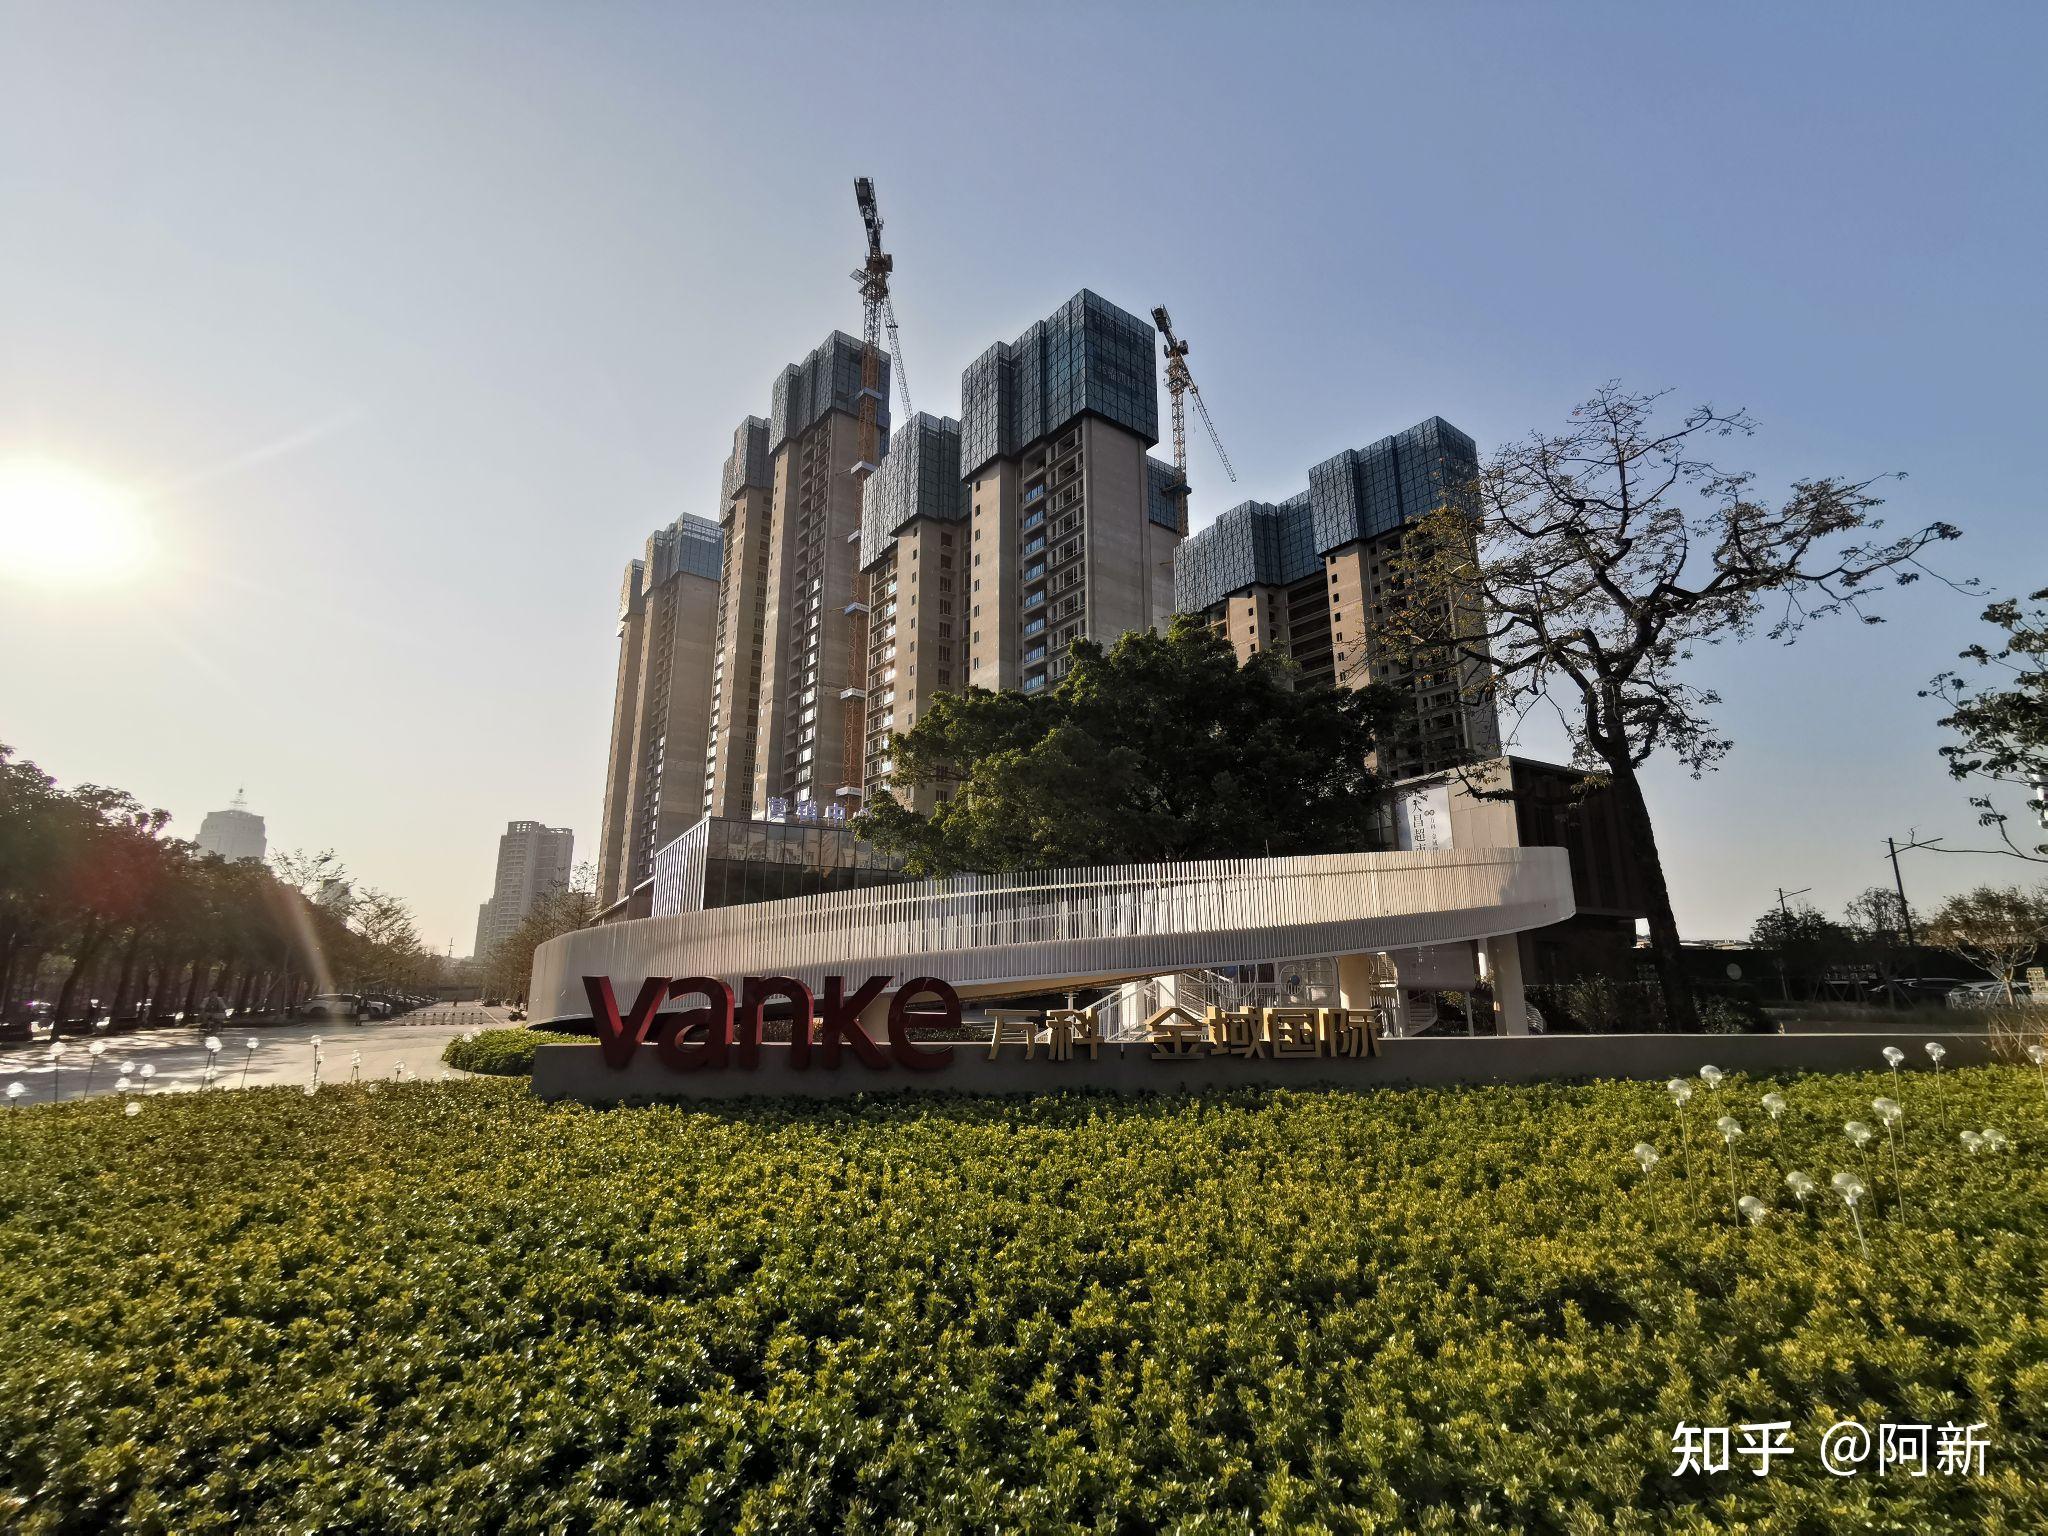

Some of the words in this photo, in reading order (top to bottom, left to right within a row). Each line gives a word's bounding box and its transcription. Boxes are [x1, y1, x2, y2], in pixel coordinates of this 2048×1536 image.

[984, 1007, 1102, 1061] 万科
[1146, 1006, 1382, 1060] 金域国际
